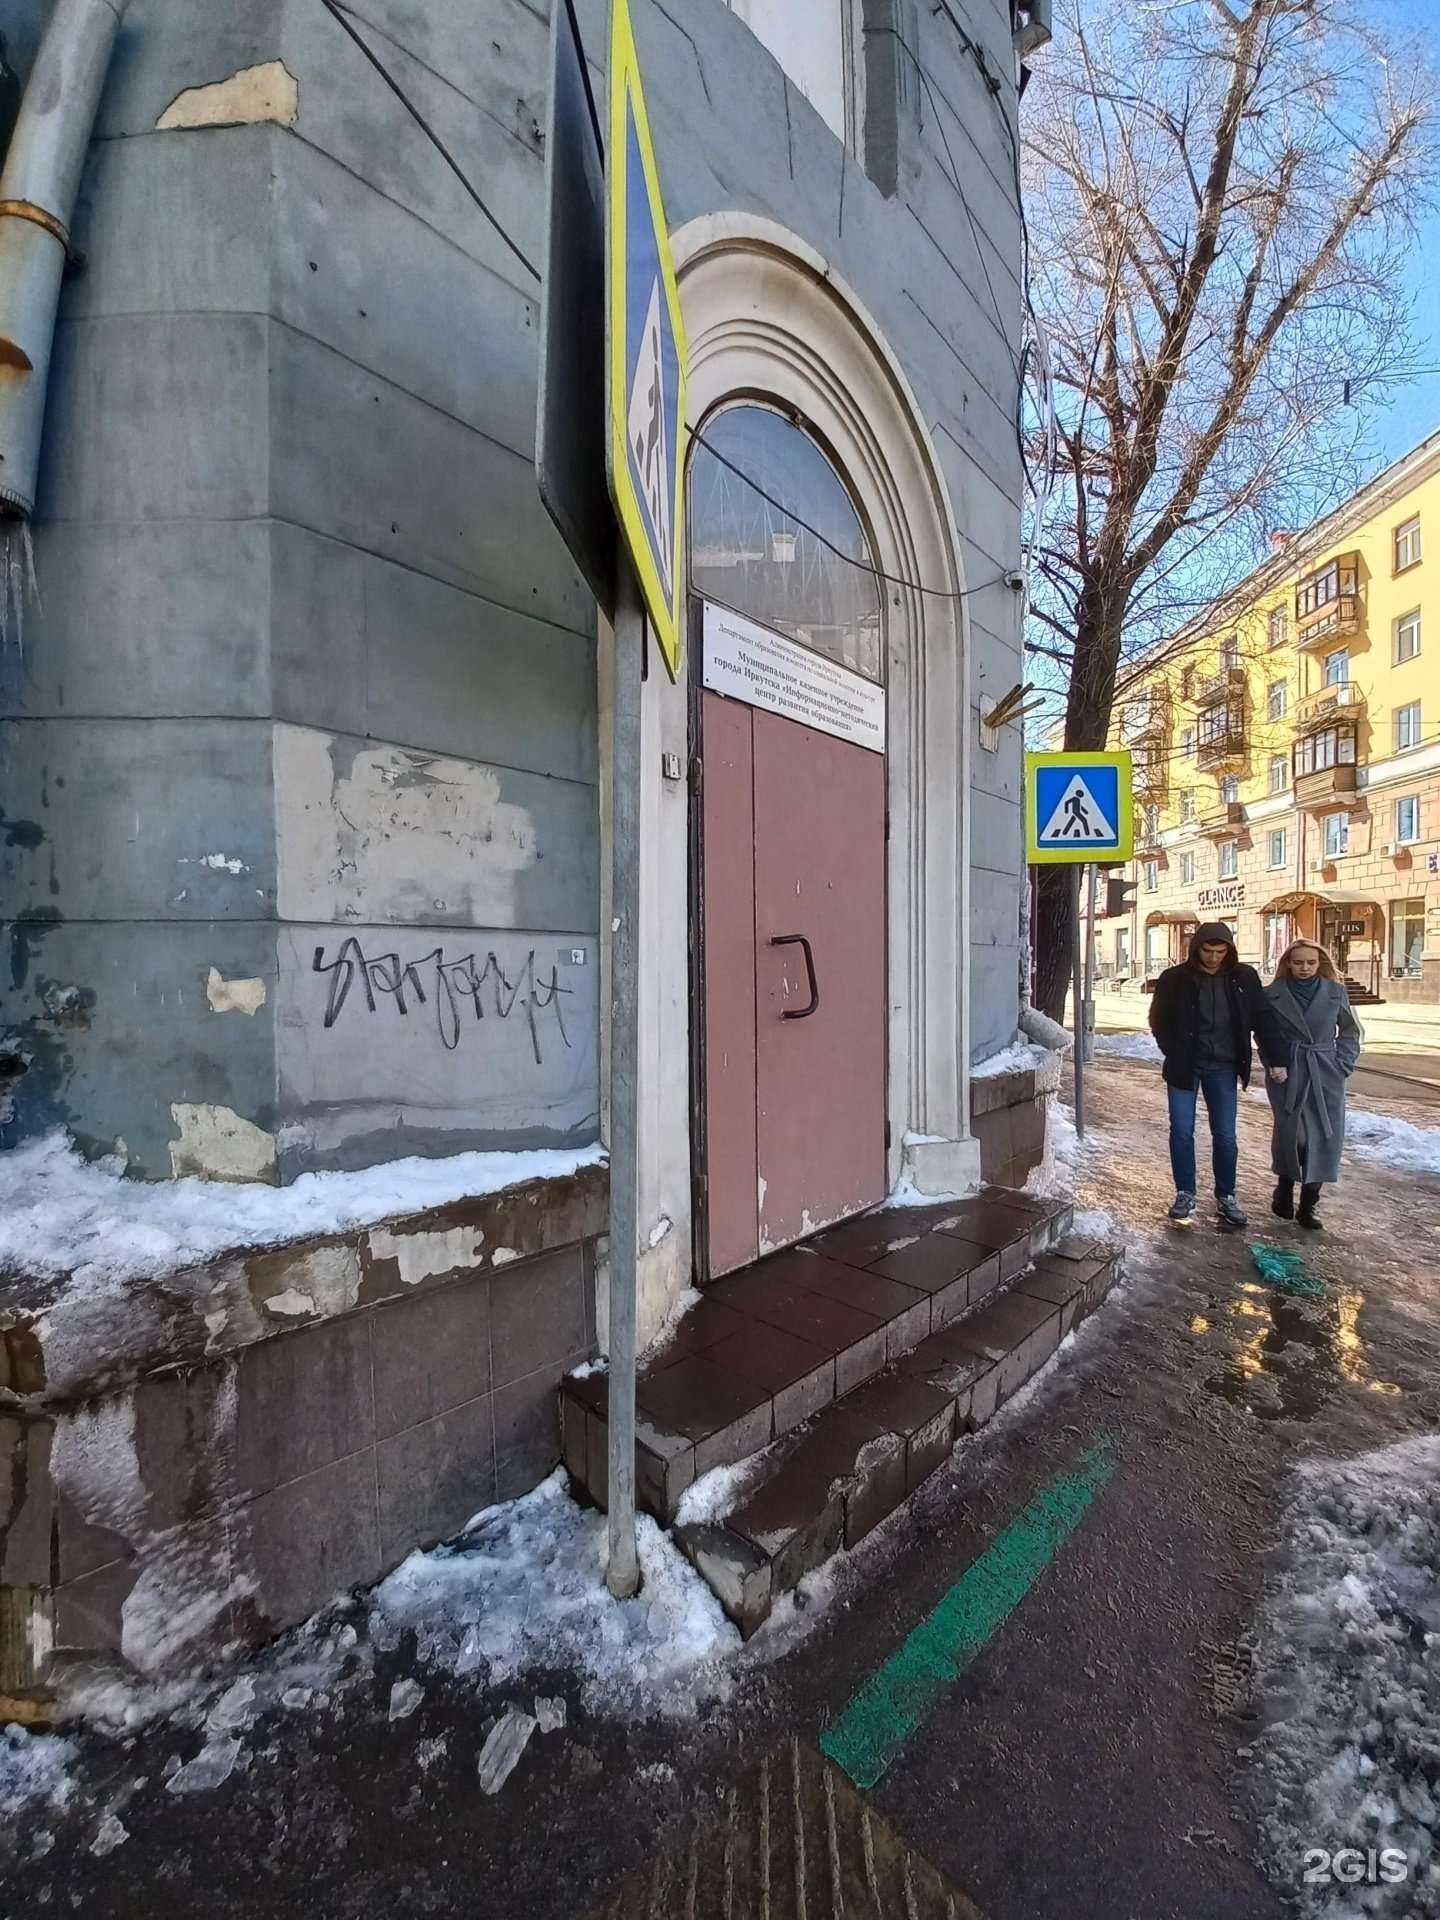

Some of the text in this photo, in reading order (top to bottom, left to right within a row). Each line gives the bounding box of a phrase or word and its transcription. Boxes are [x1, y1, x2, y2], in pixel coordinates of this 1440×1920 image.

[714, 656, 742, 675] города
[744, 666, 781, 691] Иркутска
[737, 650, 798, 684] Муниципальное
[754, 686, 777, 703] центр
[1198, 884, 1246, 906] GLANCE
